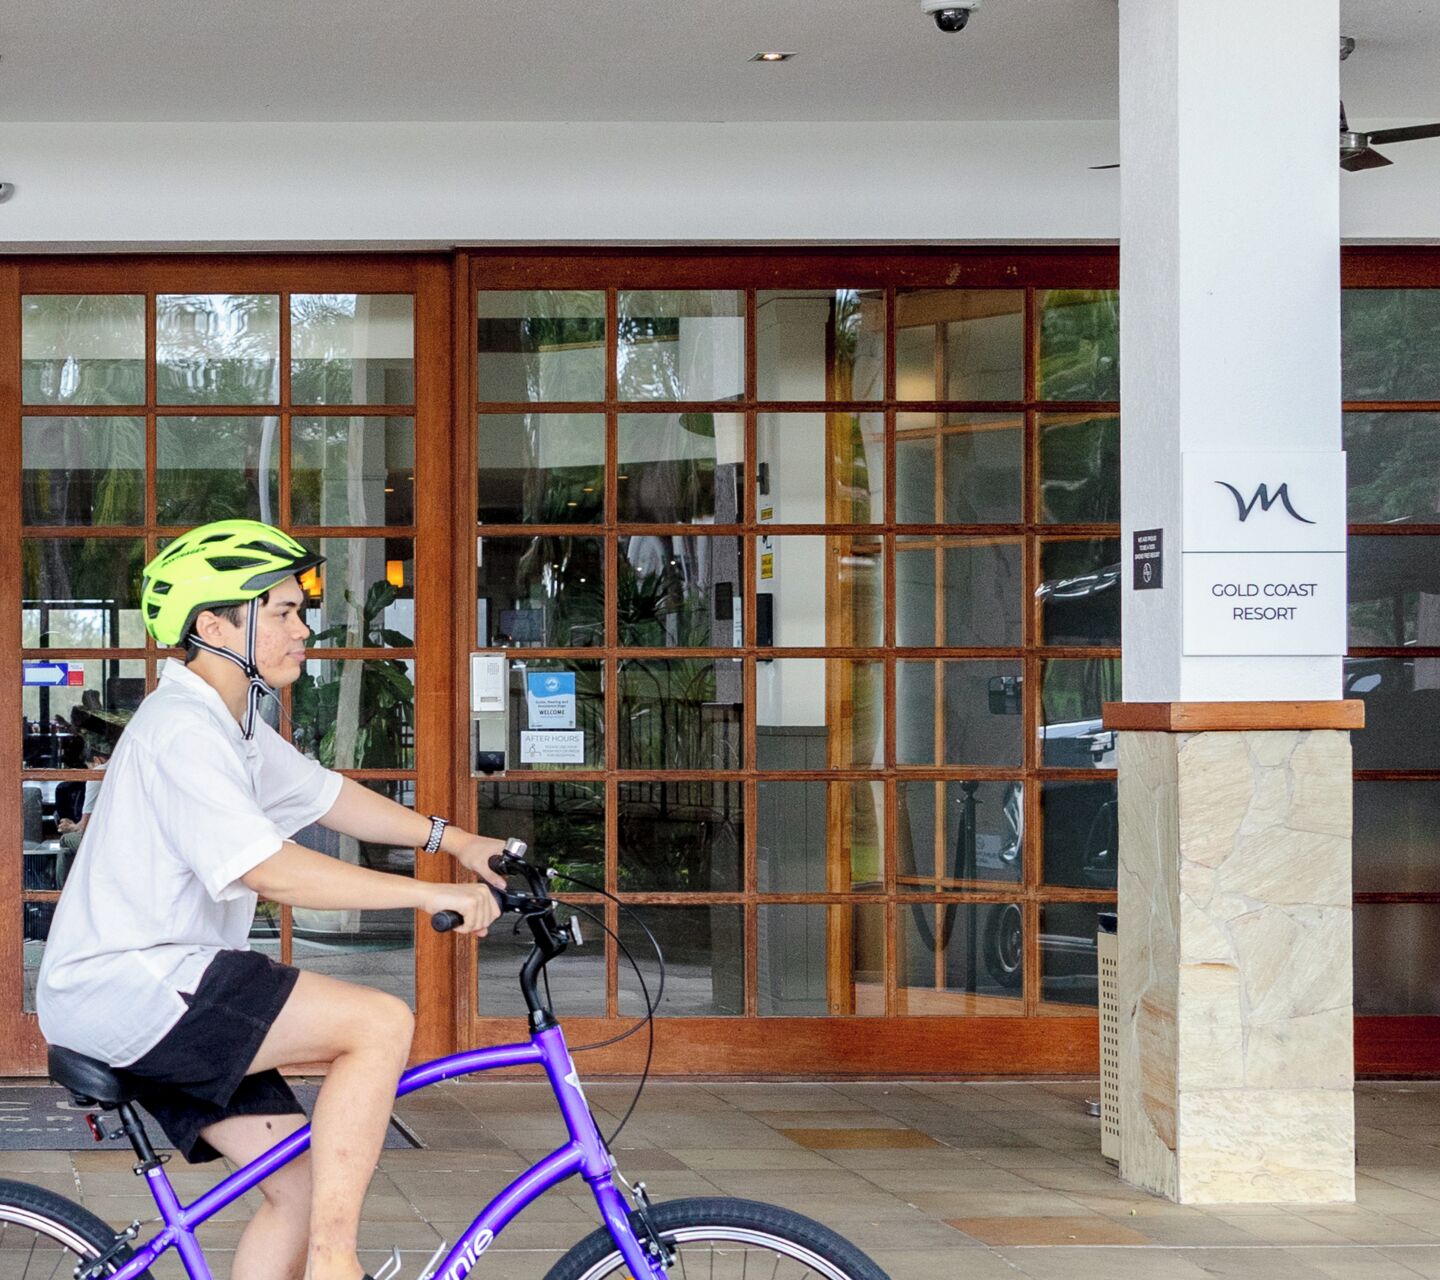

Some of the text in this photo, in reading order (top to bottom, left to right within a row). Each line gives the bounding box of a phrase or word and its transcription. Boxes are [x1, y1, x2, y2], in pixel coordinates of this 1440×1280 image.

[1211, 583, 1318, 598] GOLD COAST
[1232, 607, 1297, 621] RESORT
[526, 734, 579, 743] AFTER HOURS
